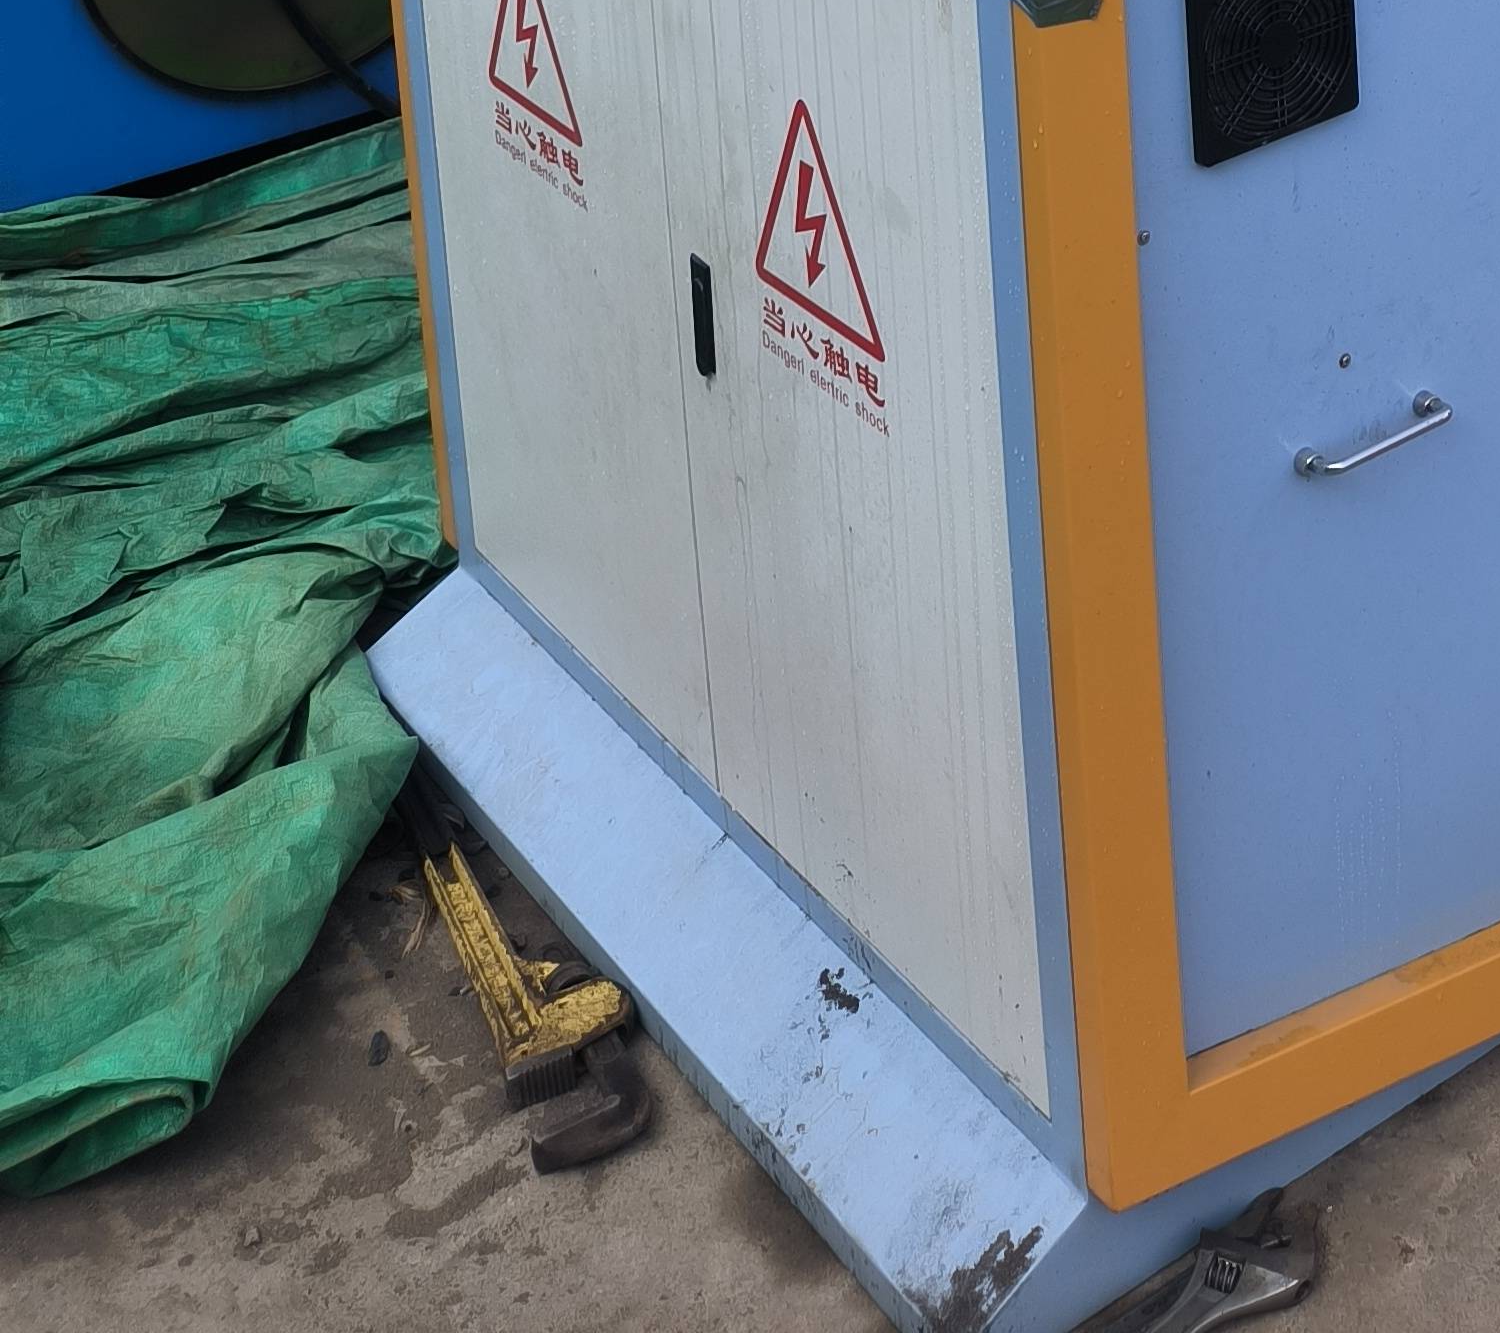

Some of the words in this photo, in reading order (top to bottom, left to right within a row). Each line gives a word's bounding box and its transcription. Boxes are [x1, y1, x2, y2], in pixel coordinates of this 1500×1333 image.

[494, 100, 584, 187] 当心触电
[562, 182, 589, 213] shock
[763, 296, 886, 408] 当心触电
[854, 401, 890, 438] shock
